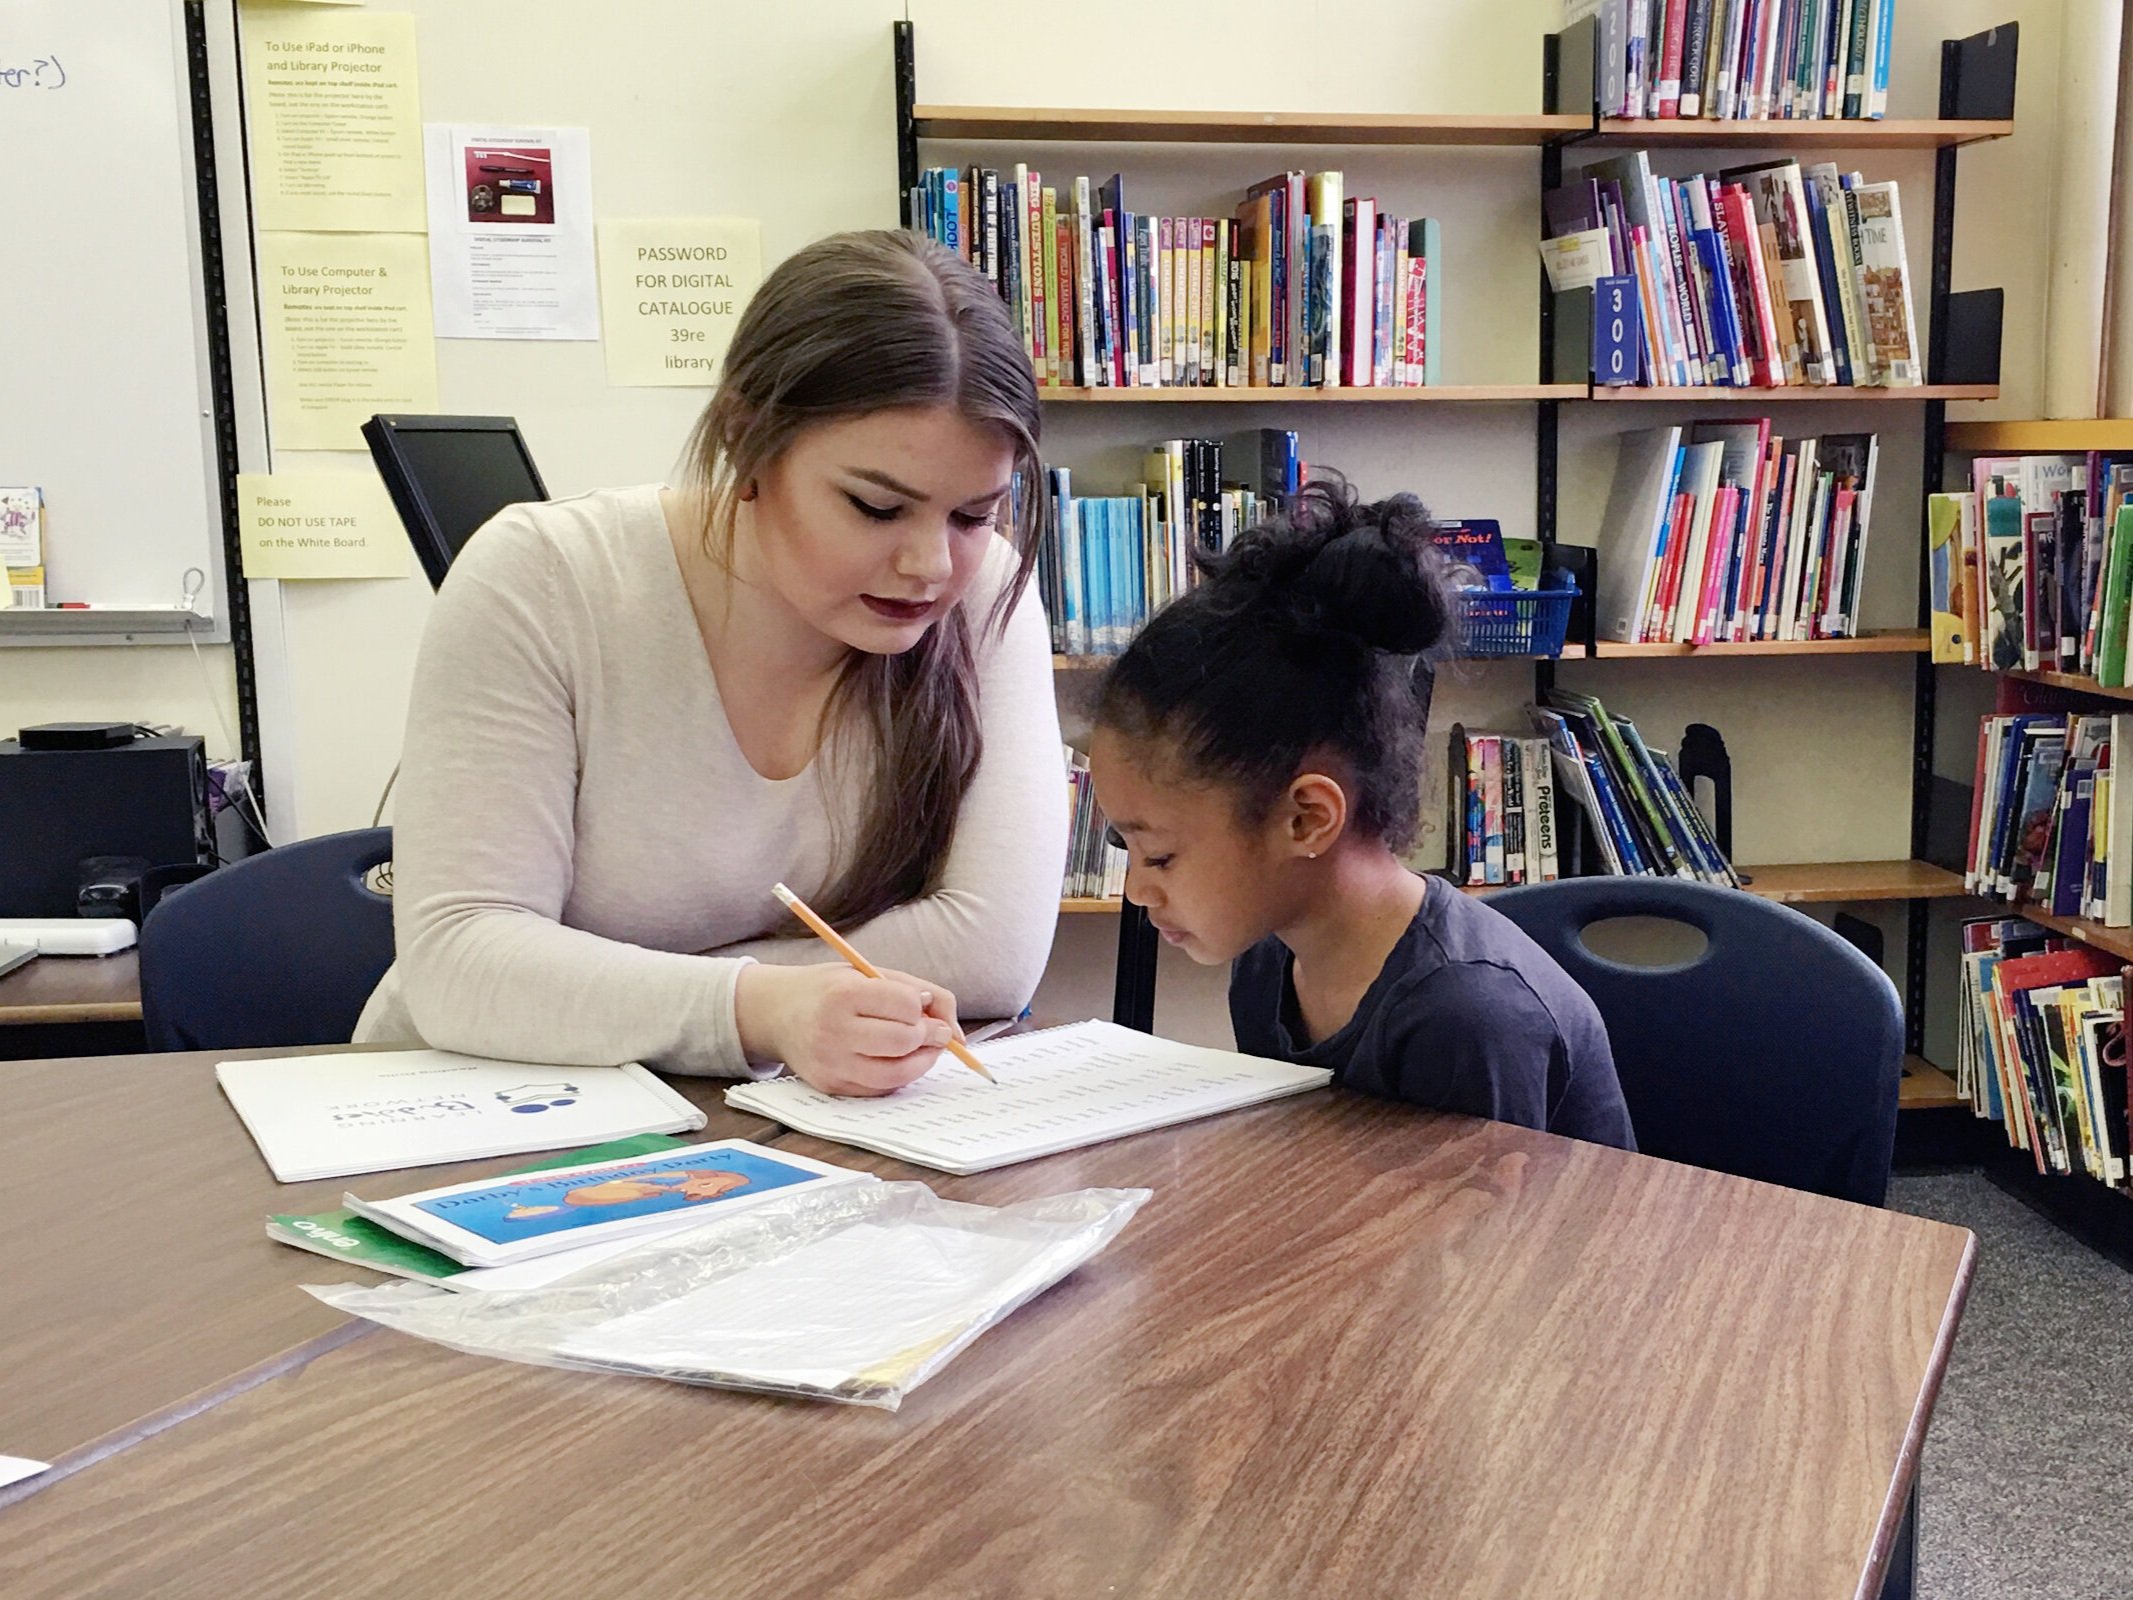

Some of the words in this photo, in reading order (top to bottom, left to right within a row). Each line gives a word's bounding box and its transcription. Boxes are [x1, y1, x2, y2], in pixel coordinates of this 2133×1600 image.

[1691, 16, 1703, 56] GREEK
[265, 41, 280, 52] To
[282, 42, 303, 52] Use
[305, 42, 329, 53] iPad
[332, 44, 343, 53] or
[347, 43, 385, 54] iPhone
[267, 61, 287, 71] and
[290, 61, 328, 73] Library
[331, 62, 382, 73] Projector
[985, 174, 998, 194] TOP
[1030, 180, 1041, 208] BIG
[986, 196, 998, 213] TEN
[987, 214, 998, 226] OF
[1713, 201, 1735, 267] SLAVERY
[1864, 228, 1888, 244] TIME
[637, 247, 728, 261] PASSWORD
[987, 227, 999, 280] EVERYTHING
[1031, 211, 1043, 297] QUESTIONS
[1060, 245, 1070, 275] WORLD
[281, 266, 295, 276] To
[297, 266, 318, 276] Use
[321, 266, 375, 278] Computer
[378, 267, 387, 277] &
[1668, 223, 1684, 270] PEOPLES
[1679, 282, 1692, 322] WORLD
[635, 274, 667, 288] FOR
[672, 274, 733, 288] DIGITAL
[282, 285, 320, 296] Library
[323, 285, 373, 297] Projector
[1061, 278, 1071, 320] ALMANAC
[638, 301, 734, 315] CATALOGUE
[671, 328, 705, 342] 39re
[1062, 322, 1071, 339] FOR
[665, 355, 714, 371] library
[256, 496, 291, 507] Please
[258, 517, 274, 527] DO
[278, 517, 301, 527] NOT
[305, 517, 326, 527] USE
[330, 517, 357, 527] TAPE
[276, 538, 294, 547] the
[297, 537, 330, 548] White
[1433, 535, 1452, 544] or
[1455, 533, 1492, 544] Not!
[1537, 786, 1552, 849] Preteens
[329, 1094, 467, 1110] NETWORK
[332, 1100, 476, 1121] Buddies
[337, 1110, 482, 1128] LEARNING
[435, 1182, 544, 1209] Darby's
[549, 1164, 657, 1190] Birthday
[665, 1151, 733, 1170] Party
